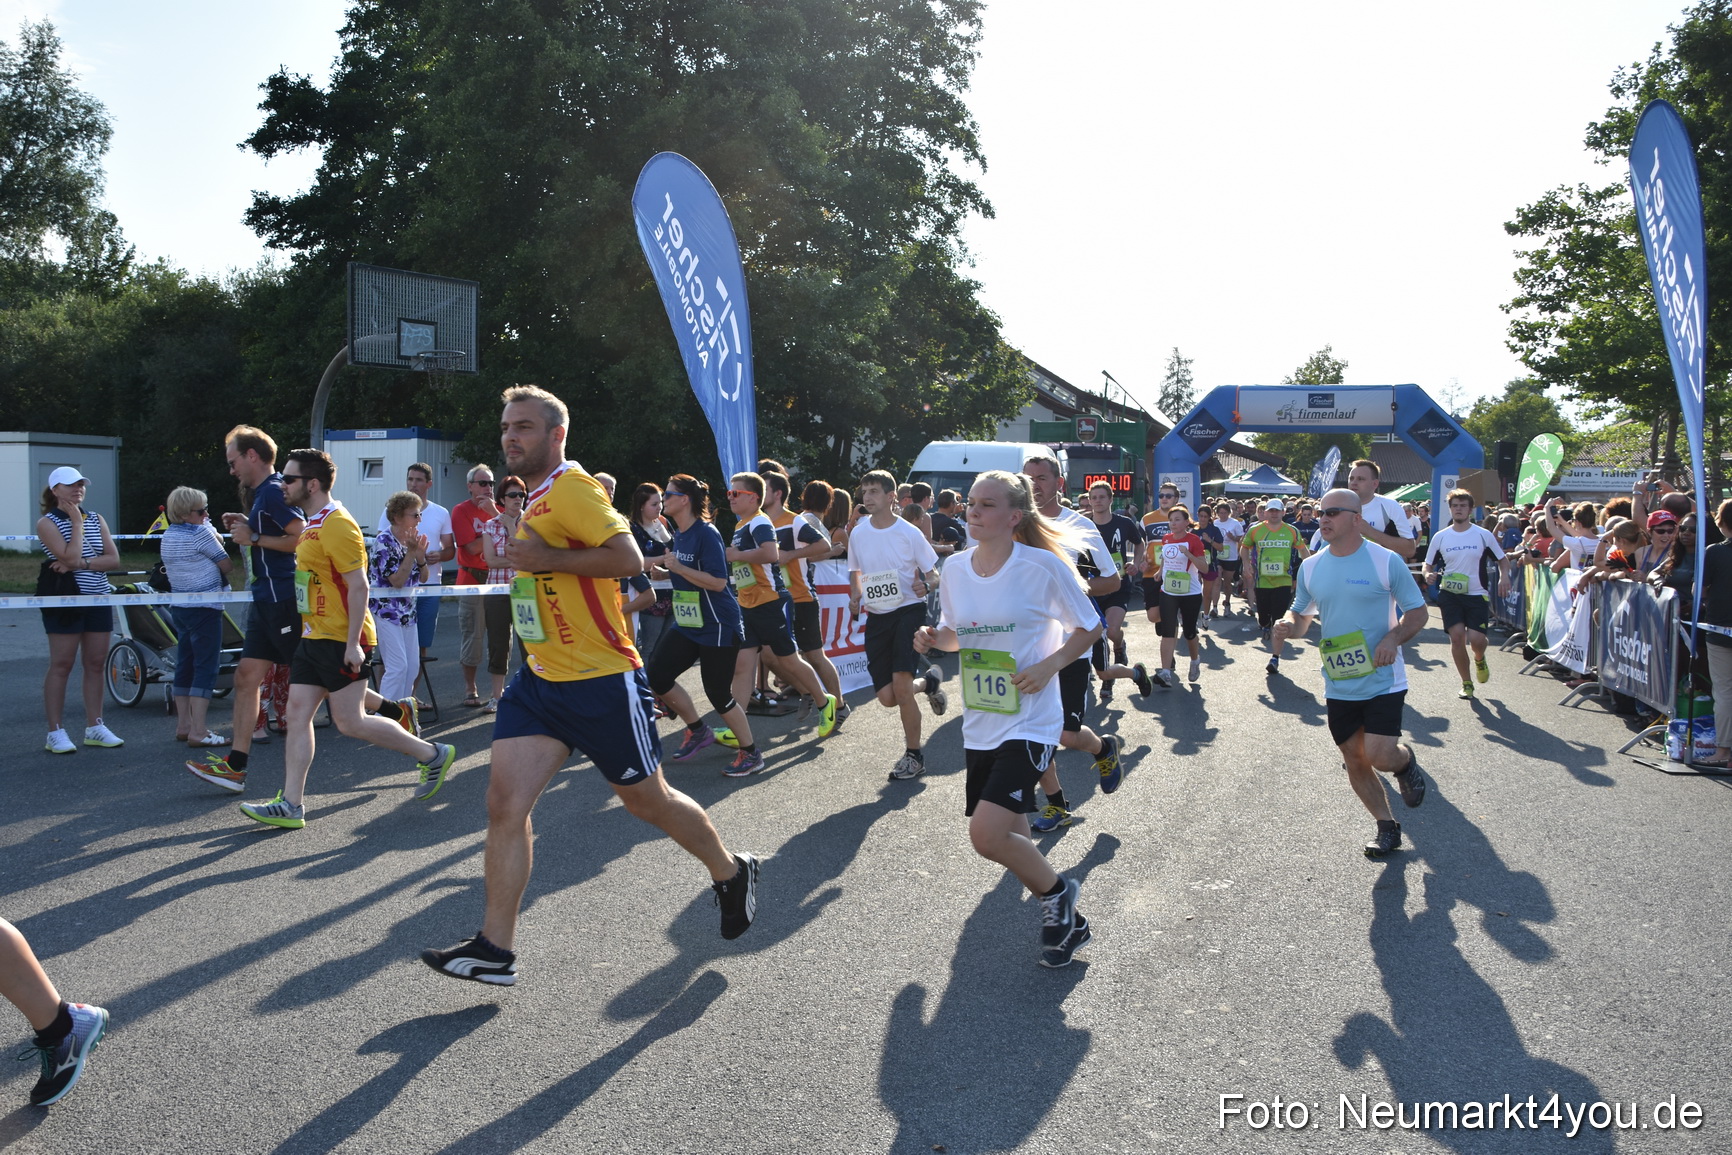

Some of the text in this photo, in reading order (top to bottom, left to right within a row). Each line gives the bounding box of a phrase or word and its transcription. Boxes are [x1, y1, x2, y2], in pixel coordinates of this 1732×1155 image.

[1299, 408, 1357, 420] firmenlauf
[1568, 470, 1592, 478] Jura
[1518, 473, 1540, 497] AOK
[1446, 545, 1478, 553] DELPHI
[1265, 563, 1280, 571] 143
[866, 582, 899, 600] 8936
[1171, 579, 1182, 589] 81
[1446, 581, 1463, 590] 270
[516, 604, 535, 626] 904
[675, 604, 698, 617] 1541
[956, 622, 1016, 637] Gleichauf
[1613, 626, 1652, 666] Fischer
[1326, 649, 1367, 670] 1435
[973, 673, 1007, 697] 116
